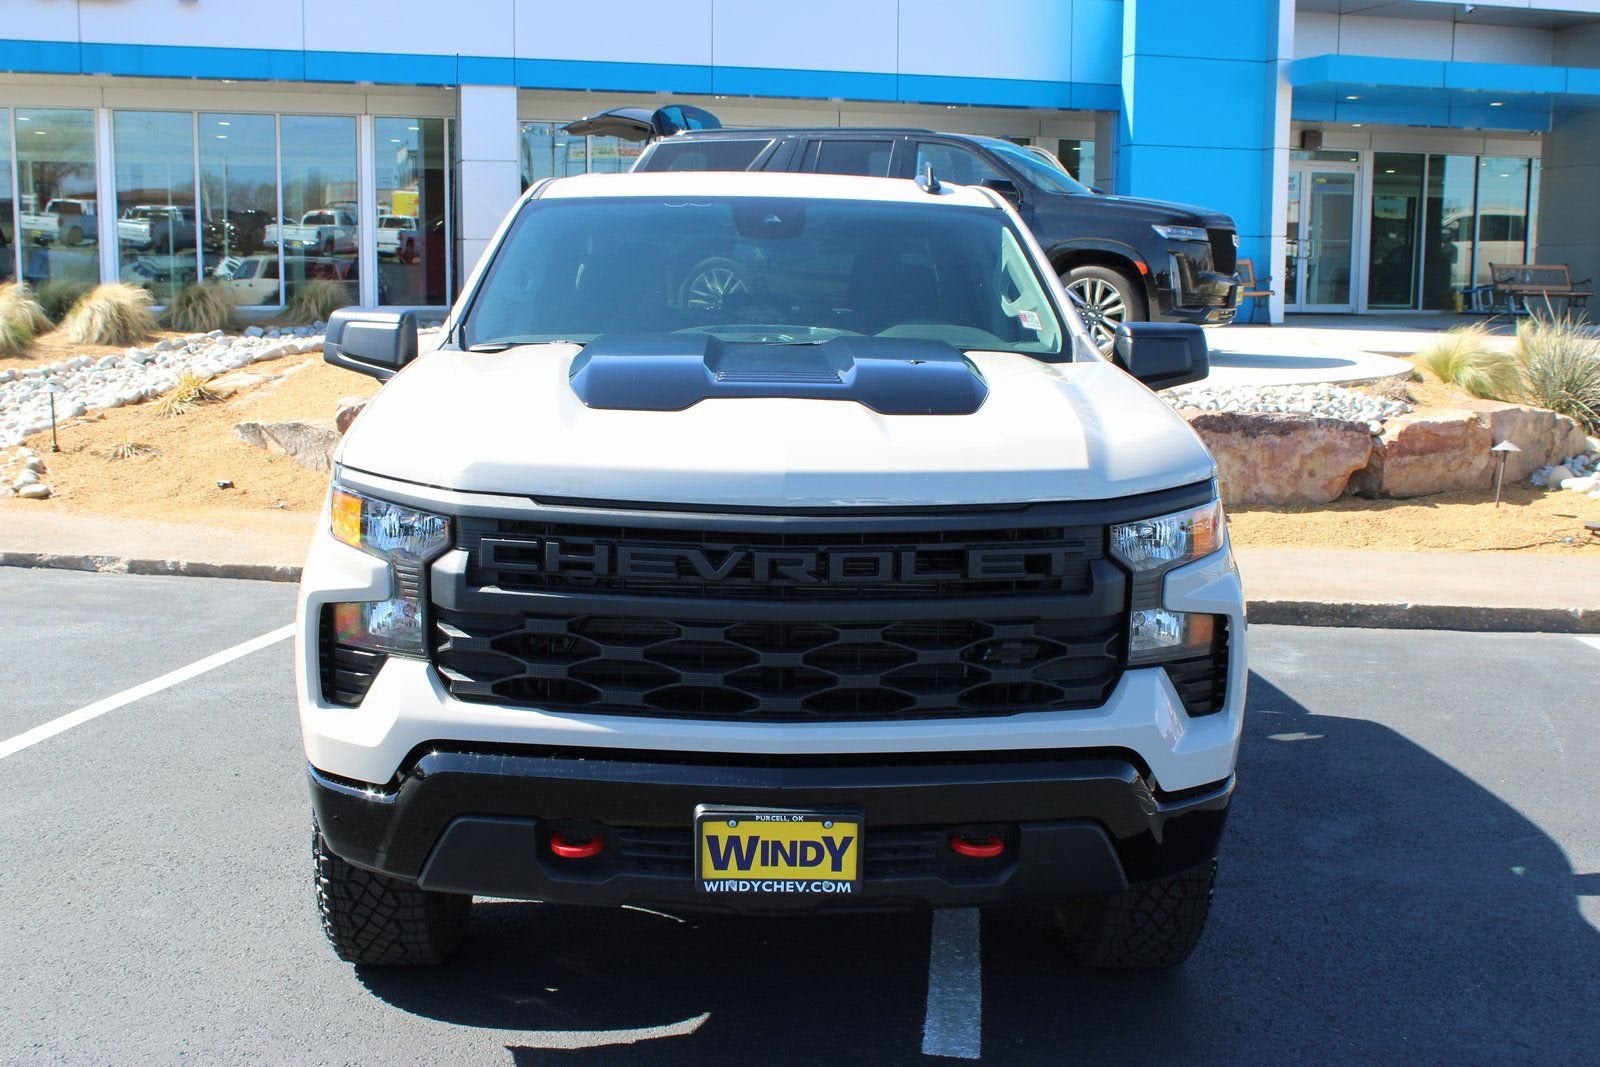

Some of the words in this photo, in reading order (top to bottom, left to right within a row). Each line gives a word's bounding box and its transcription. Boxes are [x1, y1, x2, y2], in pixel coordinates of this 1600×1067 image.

[480, 537, 1086, 583] CHEVROLET
[705, 835, 854, 872] WINDY
[704, 880, 851, 893] WINDYCHEV.COM
